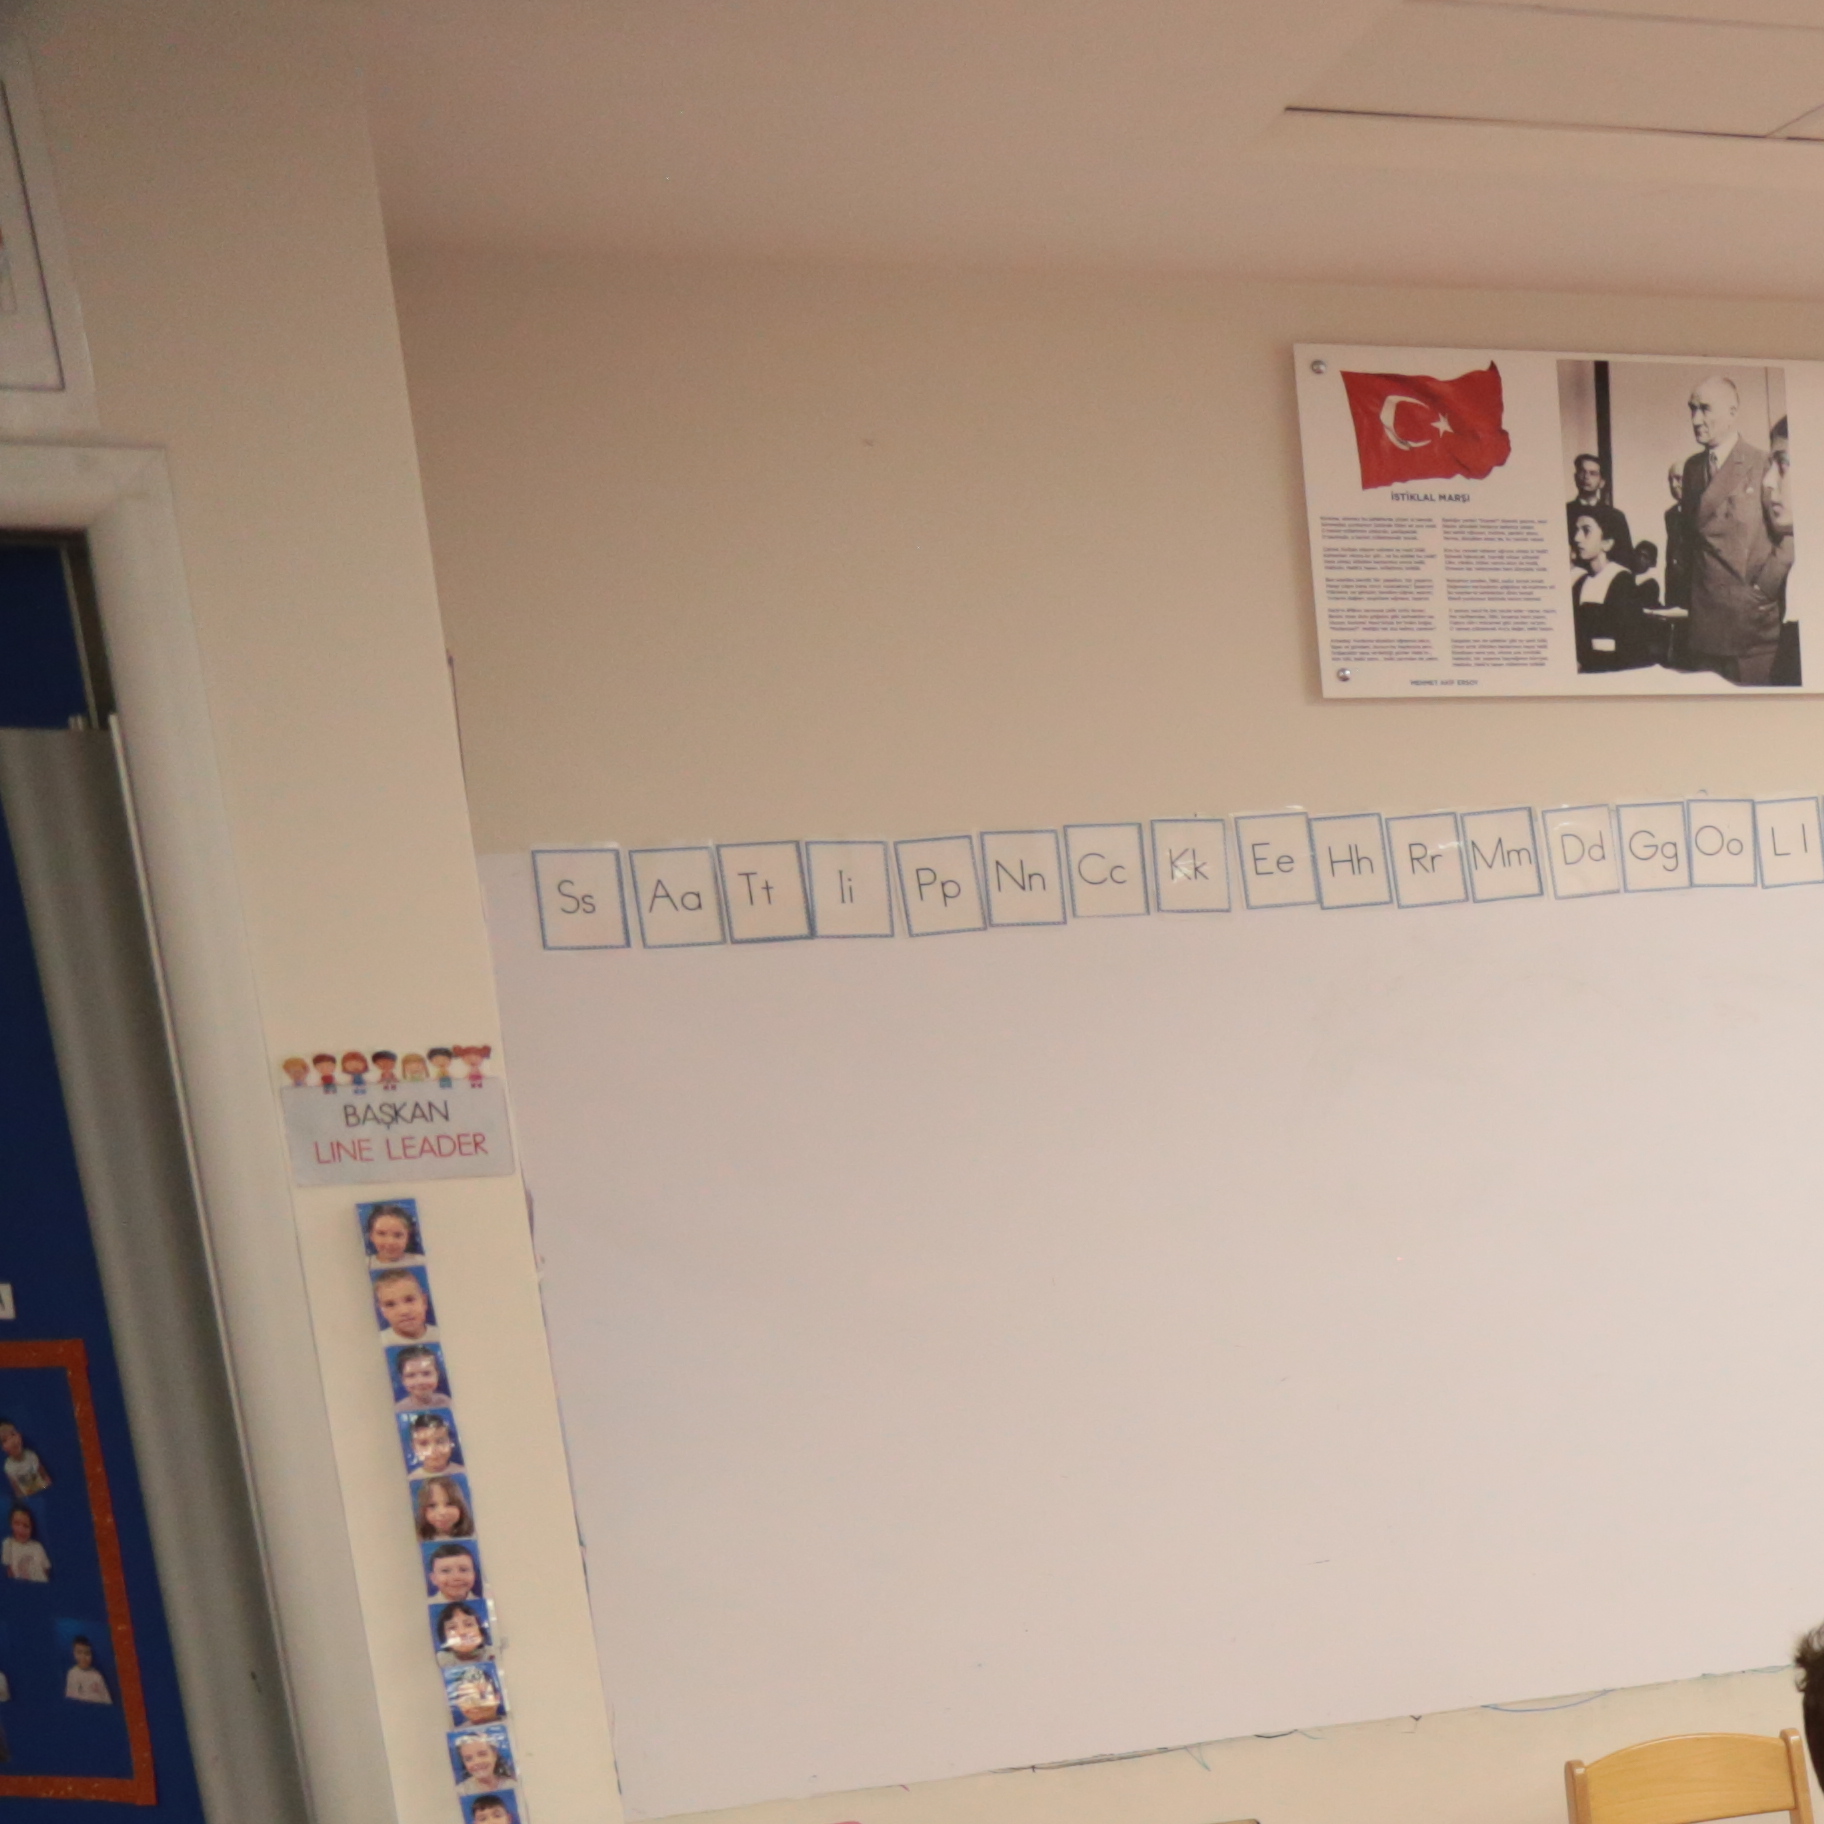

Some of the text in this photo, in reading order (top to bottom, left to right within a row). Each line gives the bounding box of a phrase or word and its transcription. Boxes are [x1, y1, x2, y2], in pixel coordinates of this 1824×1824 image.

[1391, 491, 1470, 503] İSTİKLAL MARŞI
[1473, 840, 1532, 869] Mm
[1562, 832, 1606, 866] Dd
[1629, 830, 1678, 870] Gg
[1695, 825, 1744, 856] Oo
[1078, 854, 1127, 886] Cc
[1169, 849, 1208, 881] Kk
[1252, 844, 1295, 876] Ee
[1328, 843, 1374, 877] Hh
[1410, 844, 1442, 874] Rr
[738, 871, 775, 907] Tt
[916, 868, 961, 907] Pp
[996, 860, 1046, 893] Nn
[558, 880, 596, 915] Ss
[649, 880, 703, 913] Aa
[344, 1100, 450, 1130] BAŞKAN
[314, 1133, 489, 1165] LINE LEADER
